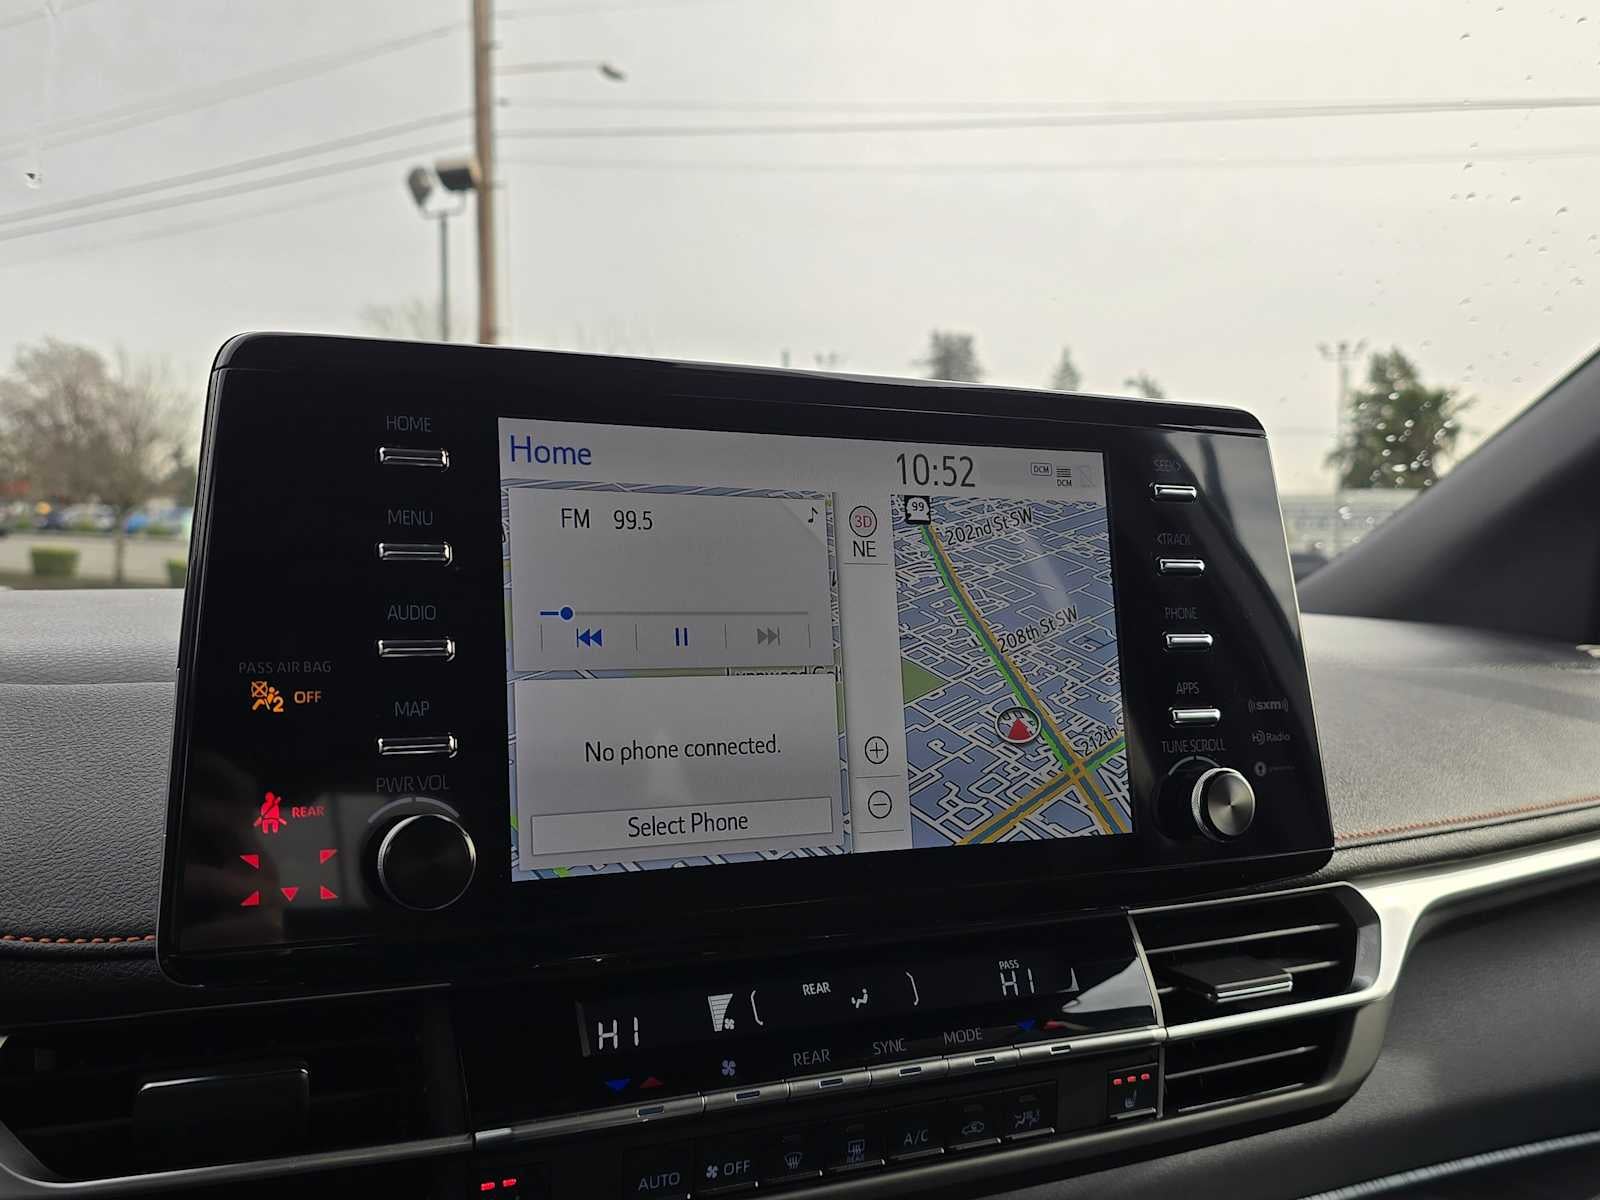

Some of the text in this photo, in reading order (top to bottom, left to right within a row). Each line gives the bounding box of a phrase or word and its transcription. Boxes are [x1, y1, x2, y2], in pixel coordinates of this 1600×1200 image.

[386, 415, 432, 432] HOME
[510, 435, 592, 466] Home
[896, 453, 976, 488] 10:52
[911, 501, 925, 512] 99
[387, 509, 434, 526] MENU
[560, 508, 654, 531] FM 99.5
[854, 513, 872, 529] 3D
[946, 506, 1034, 546] 202nd St SW
[853, 541, 877, 558] NE
[387, 604, 437, 621] AUDIO
[1165, 607, 1198, 620] PHONE
[997, 605, 1078, 654] 208th St SW
[238, 660, 332, 674] PASS AIR BAG
[293, 690, 322, 704] OFF
[1176, 682, 1200, 695] APPS
[394, 700, 430, 718] MAP
[585, 733, 783, 766] No phone connected.
[1081, 724, 1118, 757] 212th
[376, 774, 449, 793] PWR VOL
[291, 805, 325, 818] REAR
[627, 811, 749, 838] Select Phone
[998, 959, 1020, 970] PASS
[802, 981, 831, 996] REAR
[943, 1027, 984, 1046] MODE
[872, 1038, 907, 1056] SYNC
[792, 1048, 831, 1067] REAR
[903, 1128, 929, 1146] A/C
[723, 1159, 751, 1177] OFF
[637, 1171, 681, 1193] AUTO
